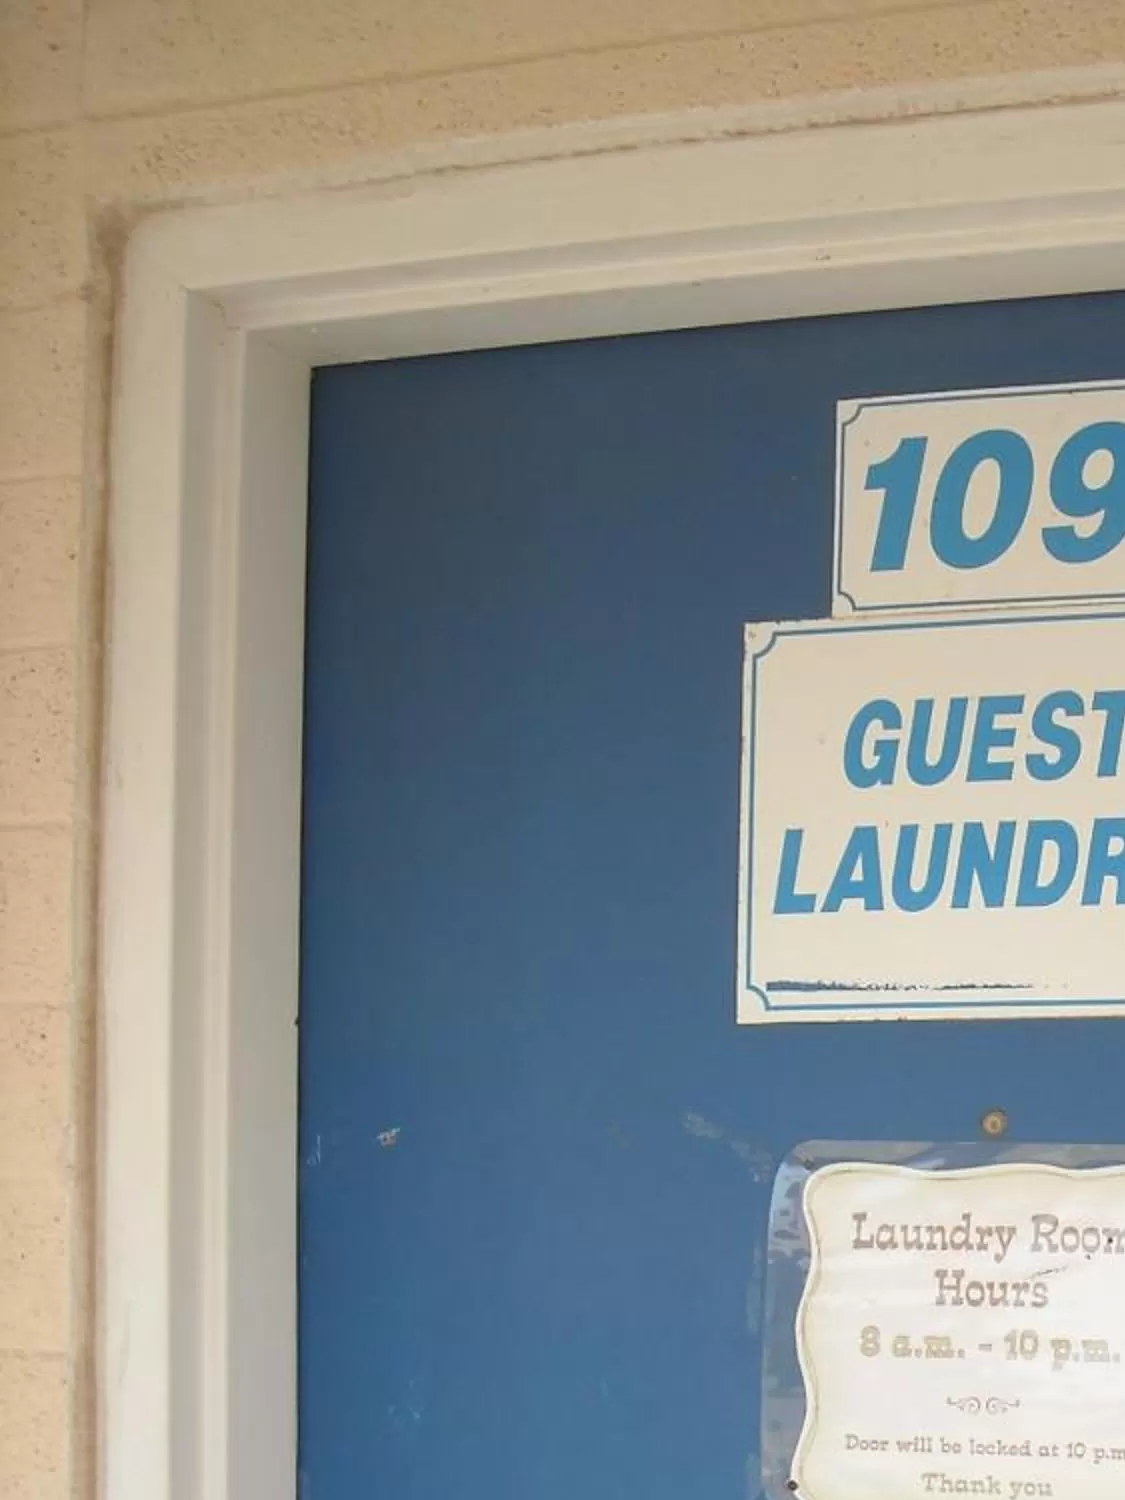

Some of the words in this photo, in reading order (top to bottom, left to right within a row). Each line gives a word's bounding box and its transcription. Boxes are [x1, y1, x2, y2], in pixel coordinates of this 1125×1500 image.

[851, 1212, 1016, 1263] Laundry
[934, 1269, 1049, 1309] Hours
[860, 1325, 880, 1357] 8
[891, 1334, 965, 1359] a.m.
[1004, 1329, 1038, 1359] 10
[1050, 1337, 1120, 1372] p.m.
[845, 1434, 889, 1453] Door
[896, 1436, 932, 1454] will
[941, 1437, 962, 1454] be
[969, 1439, 1032, 1457] locked
[1038, 1442, 1060, 1458] at
[1067, 1441, 1086, 1459] 10
[922, 1472, 1001, 1495] Thank
[1010, 1477, 1053, 1500] you
